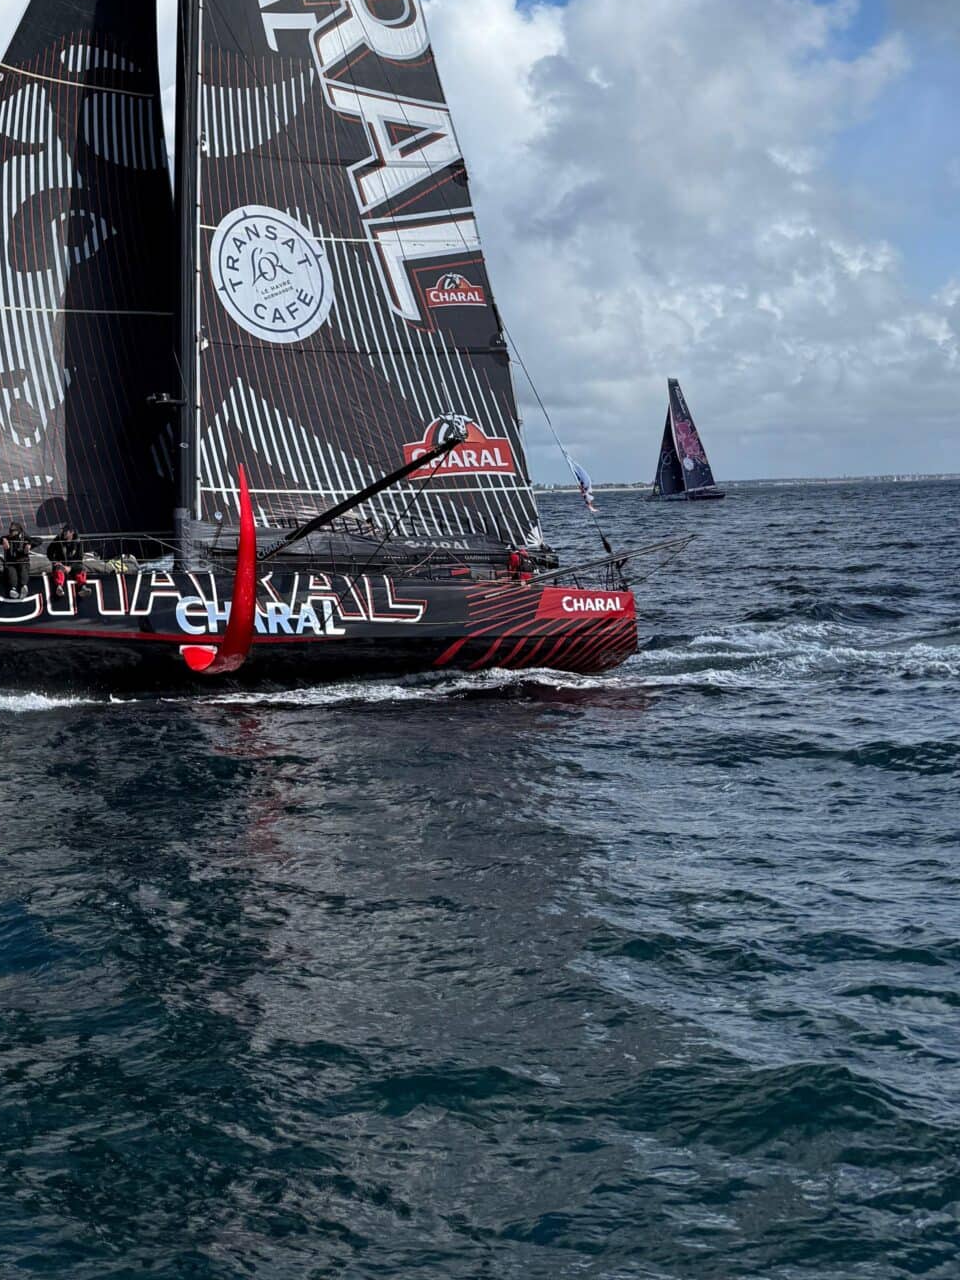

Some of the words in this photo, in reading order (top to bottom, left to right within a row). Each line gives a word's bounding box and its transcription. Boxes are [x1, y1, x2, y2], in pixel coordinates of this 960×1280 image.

[226, 223, 312, 293] TRANSAT
[270, 280, 291, 291] HAVRE
[429, 290, 483, 302] CHARAL
[253, 288, 314, 324] CAFÉ
[561, 595, 625, 612] CHARAL
